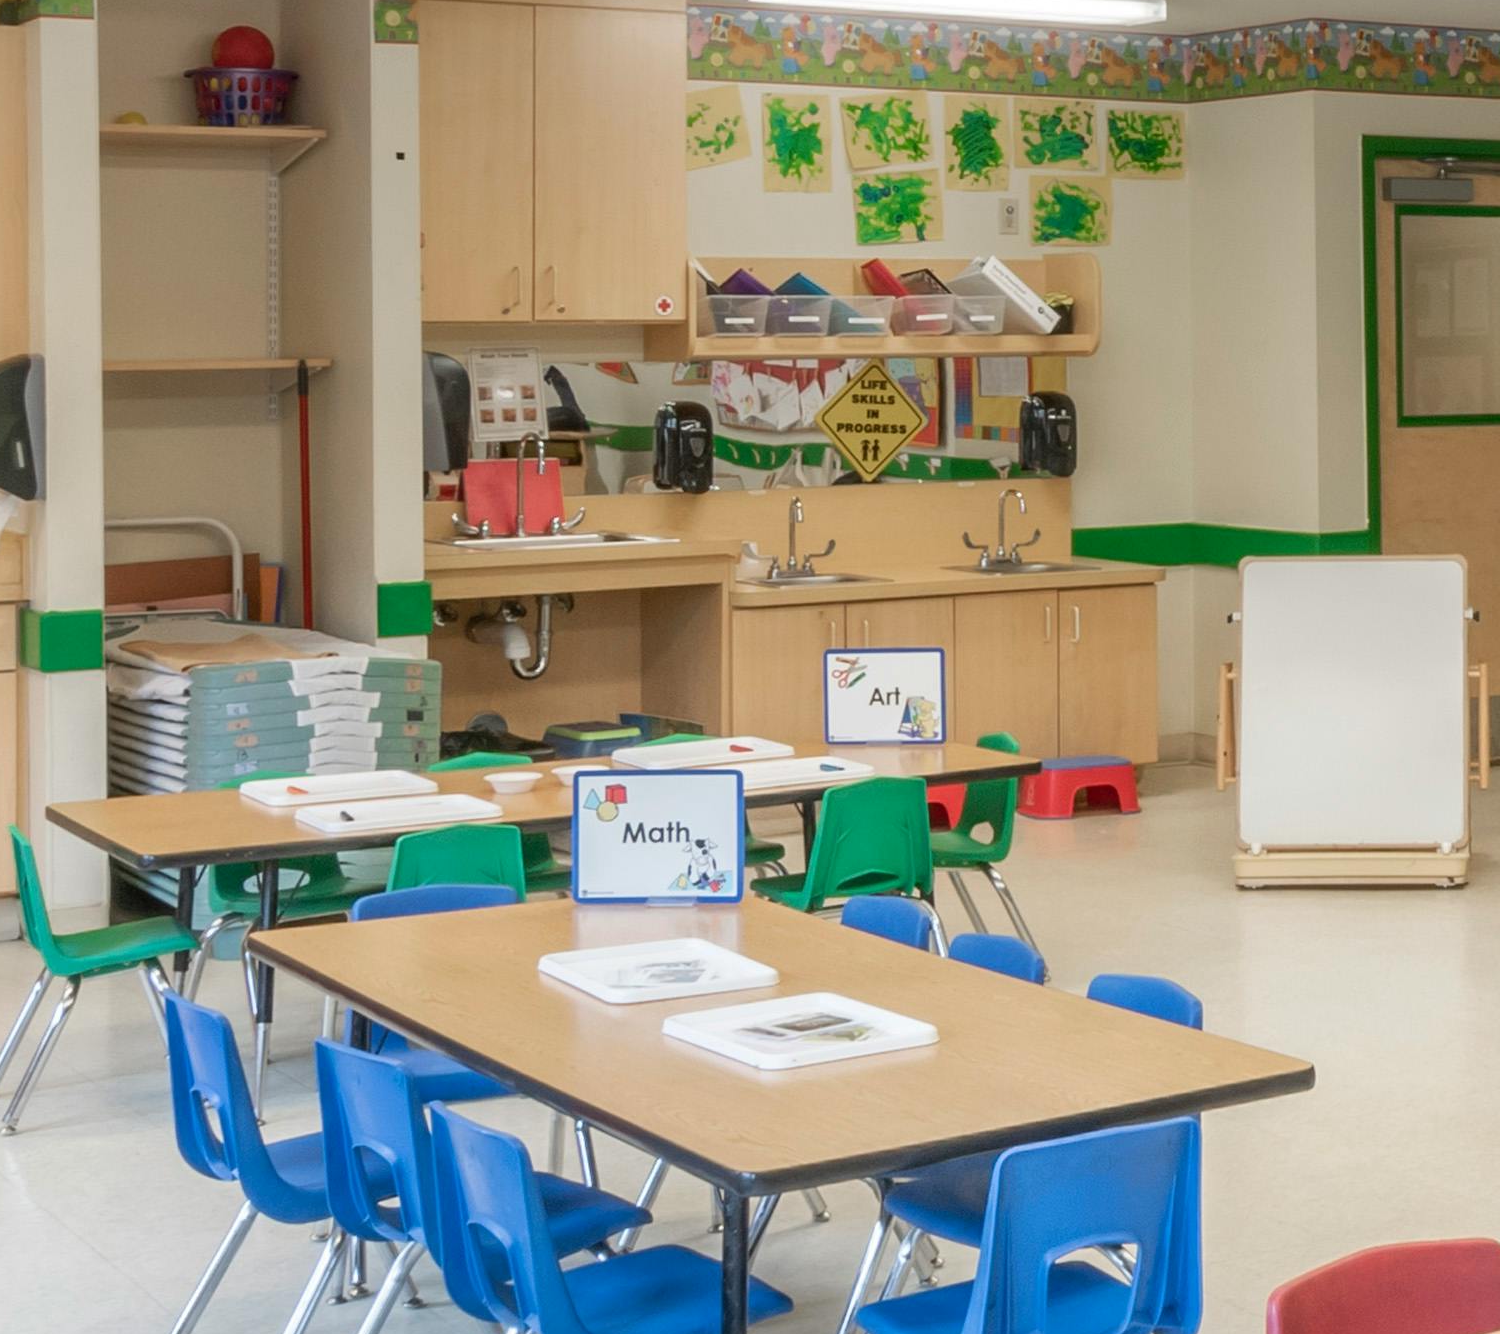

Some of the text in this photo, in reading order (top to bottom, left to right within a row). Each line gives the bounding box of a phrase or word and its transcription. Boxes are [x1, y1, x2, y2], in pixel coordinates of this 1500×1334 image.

[860, 379, 888, 391] LIFE
[851, 394, 896, 406] SKILLS
[866, 409, 879, 419] IN
[836, 423, 908, 435] PROGRESS
[869, 687, 901, 706] Art
[622, 821, 691, 844] Math
